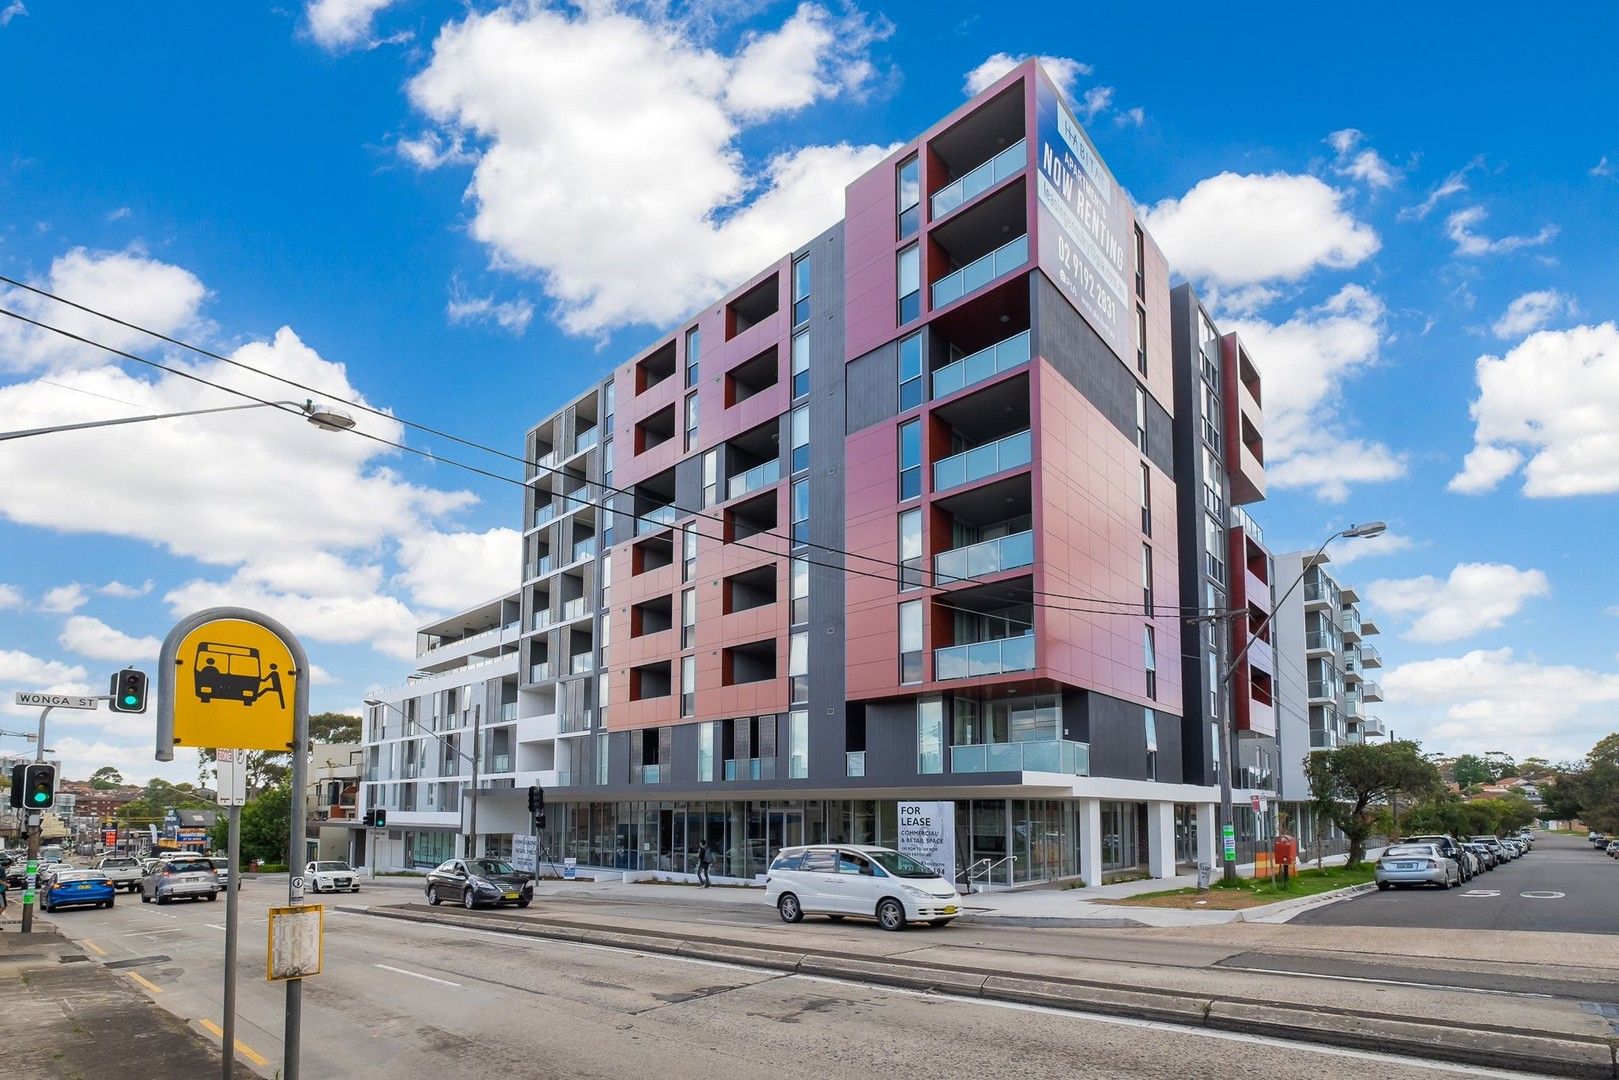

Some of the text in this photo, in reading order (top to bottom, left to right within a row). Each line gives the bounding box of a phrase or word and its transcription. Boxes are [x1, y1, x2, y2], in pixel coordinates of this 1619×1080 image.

[1064, 151, 1106, 219] APARTMENTS
[1043, 141, 1073, 203] NOW
[1078, 188, 1123, 271] RENTING
[1058, 235, 1070, 270] 02
[1073, 253, 1094, 299] 9192
[1097, 283, 1116, 325] 2831
[20, 694, 94, 706] WONGA ST
[901, 806, 921, 815] FOR
[901, 817, 931, 826] LEASE
